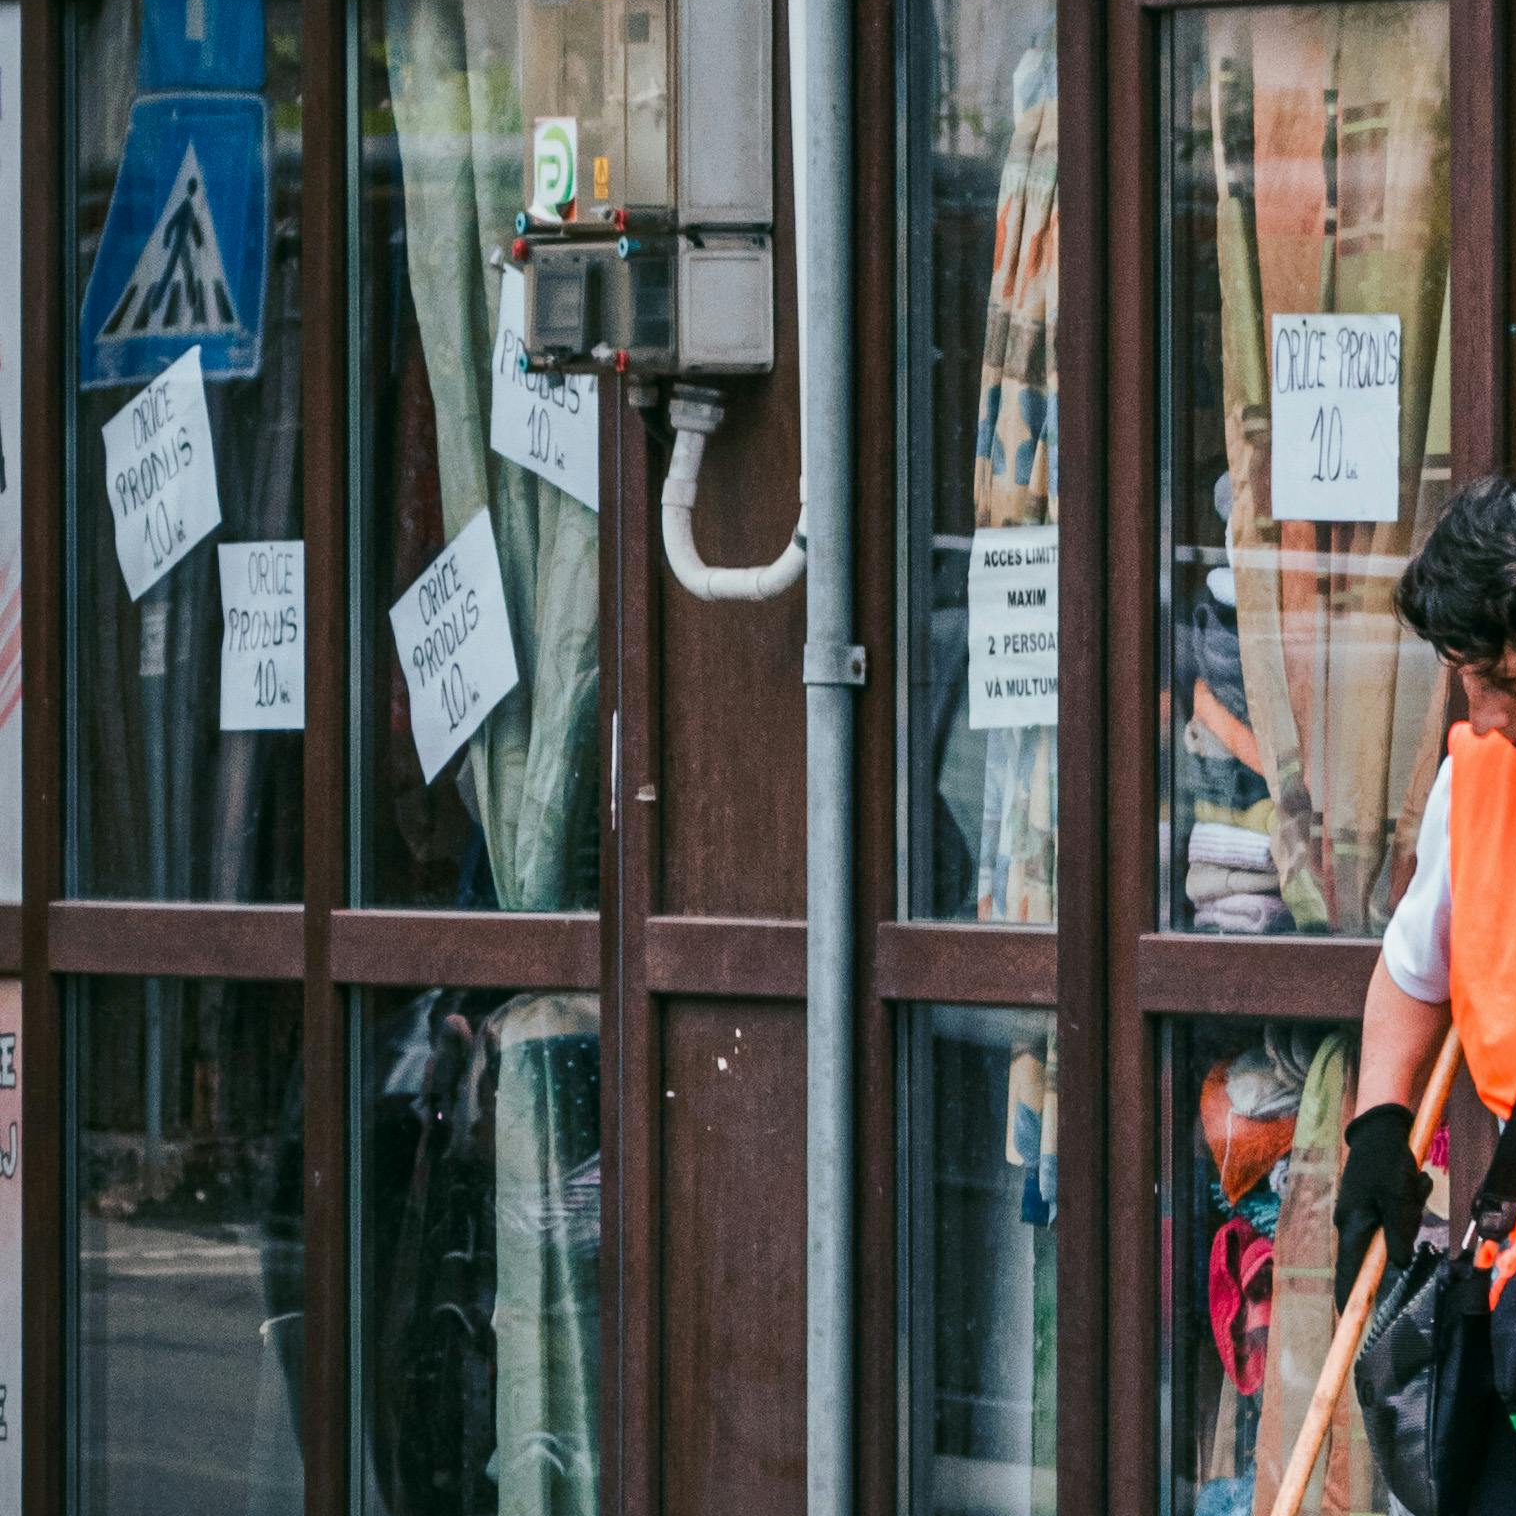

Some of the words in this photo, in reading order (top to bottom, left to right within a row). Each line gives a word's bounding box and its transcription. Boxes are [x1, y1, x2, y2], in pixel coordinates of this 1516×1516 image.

[526, 403, 551, 464] 10
[1310, 406, 1343, 482] 10
[143, 500, 173, 569] 10
[984, 548, 1023, 569] ACCES
[1007, 587, 1047, 608] MAXIM
[987, 635, 996, 656] 2
[1003, 631, 1057, 655] PERSOA
[254, 658, 278, 708] 10
[440, 661, 468, 733] 10
